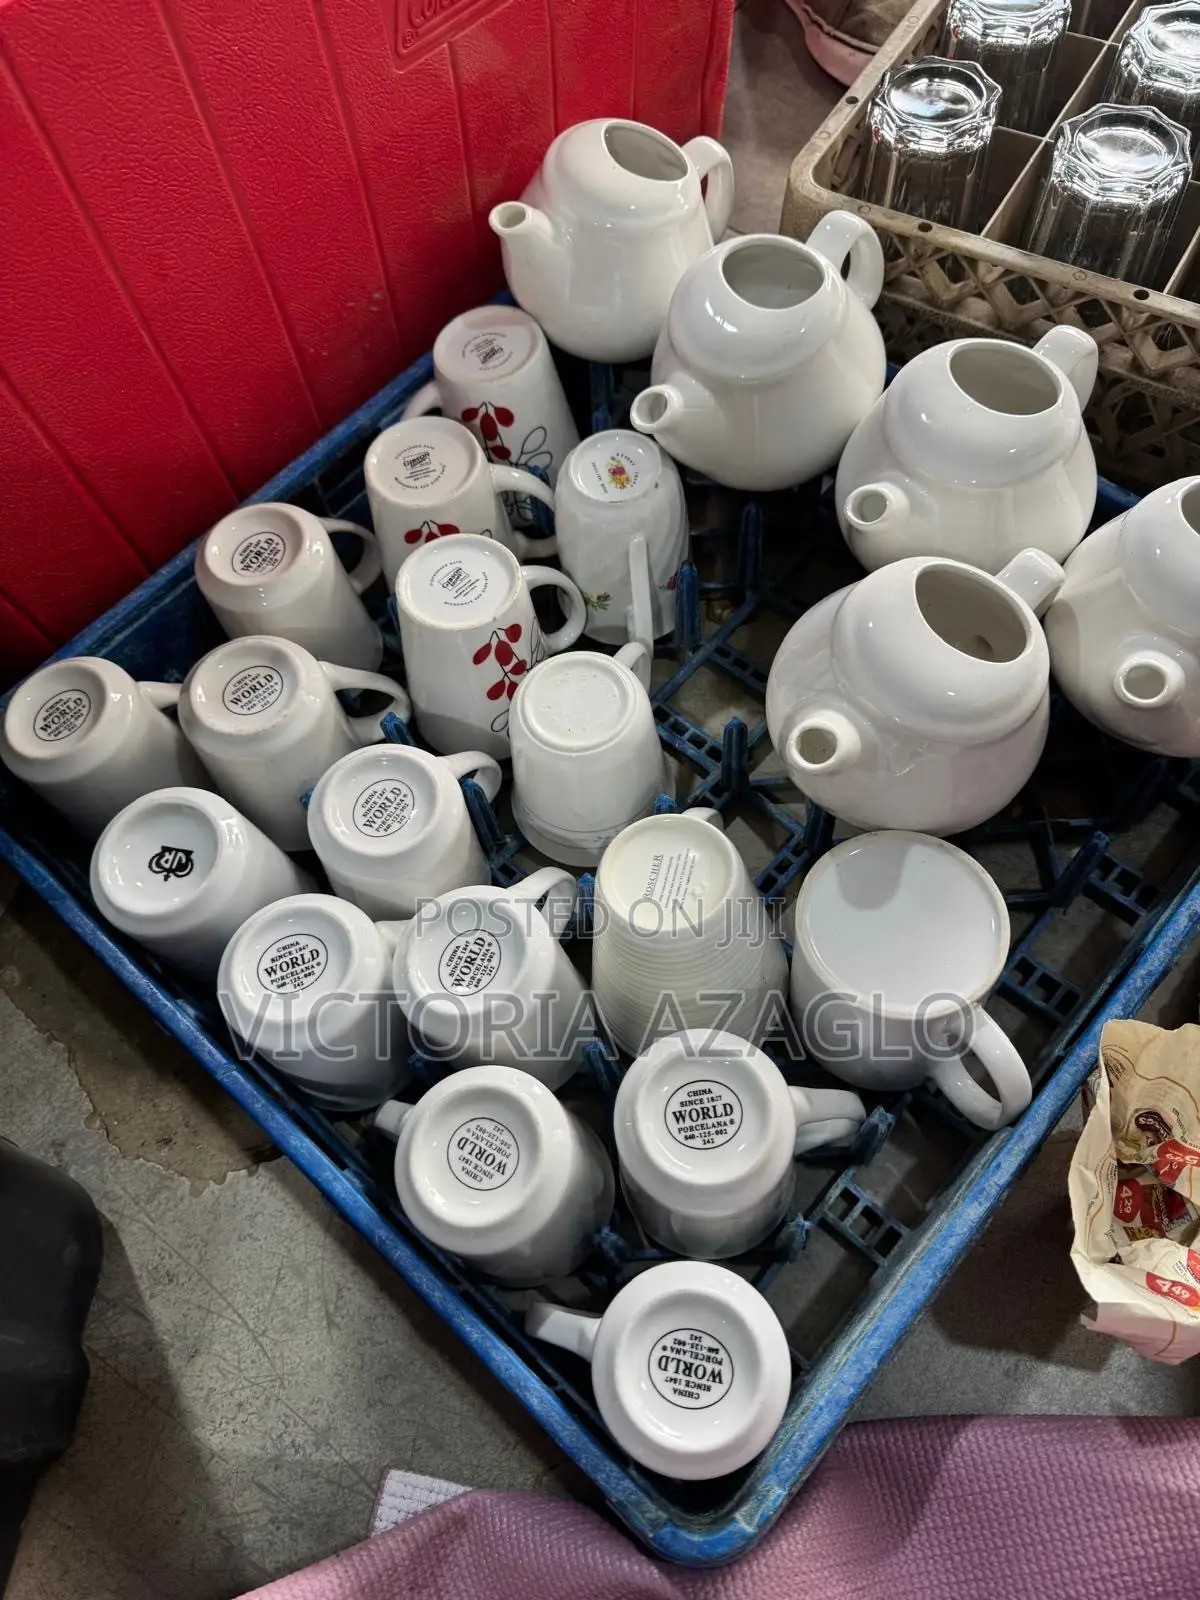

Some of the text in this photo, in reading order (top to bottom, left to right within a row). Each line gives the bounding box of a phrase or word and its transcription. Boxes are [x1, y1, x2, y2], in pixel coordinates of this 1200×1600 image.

[240, 538, 275, 571] WORLD
[230, 674, 274, 705] WORLD
[231, 682, 249, 695] SINCE
[233, 673, 252, 687] CHINA
[45, 699, 64, 713] CHINA
[240, 684, 274, 709] PORCELANA
[40, 698, 83, 732] WORLD
[43, 706, 60, 722] SINCE
[361, 790, 378, 808] CHINA
[361, 800, 379, 818] SINCE
[362, 787, 402, 828] WORLD
[375, 799, 405, 832] PORCELANA
[643, 854, 663, 900] ROSCHER
[270, 944, 309, 964] SINCE 1847
[276, 940, 300, 952] CHINA
[446, 945, 461, 967] CHINA
[264, 948, 320, 978] WORLD
[448, 940, 471, 978] SINCE 1847
[451, 937, 486, 987] WORLD
[465, 948, 491, 989] PORCELANA
[270, 964, 316, 985] PORCELANA
[680, 1098, 704, 1108] SINCE
[687, 1088, 713, 1097] CHINA
[672, 1102, 734, 1124] WORLD
[677, 1120, 728, 1134] PORCELANA
[457, 1136, 507, 1175] WORLD
[471, 1131, 511, 1159] PORCELANA
[462, 1166, 483, 1183] CHINA
[473, 1163, 495, 1180] SINCE
[670, 1345, 723, 1366] PORCELANA
[657, 1355, 723, 1384] WORLD
[664, 1376, 712, 1392] SINCE 1847
[672, 1387, 700, 1400] CHINA
